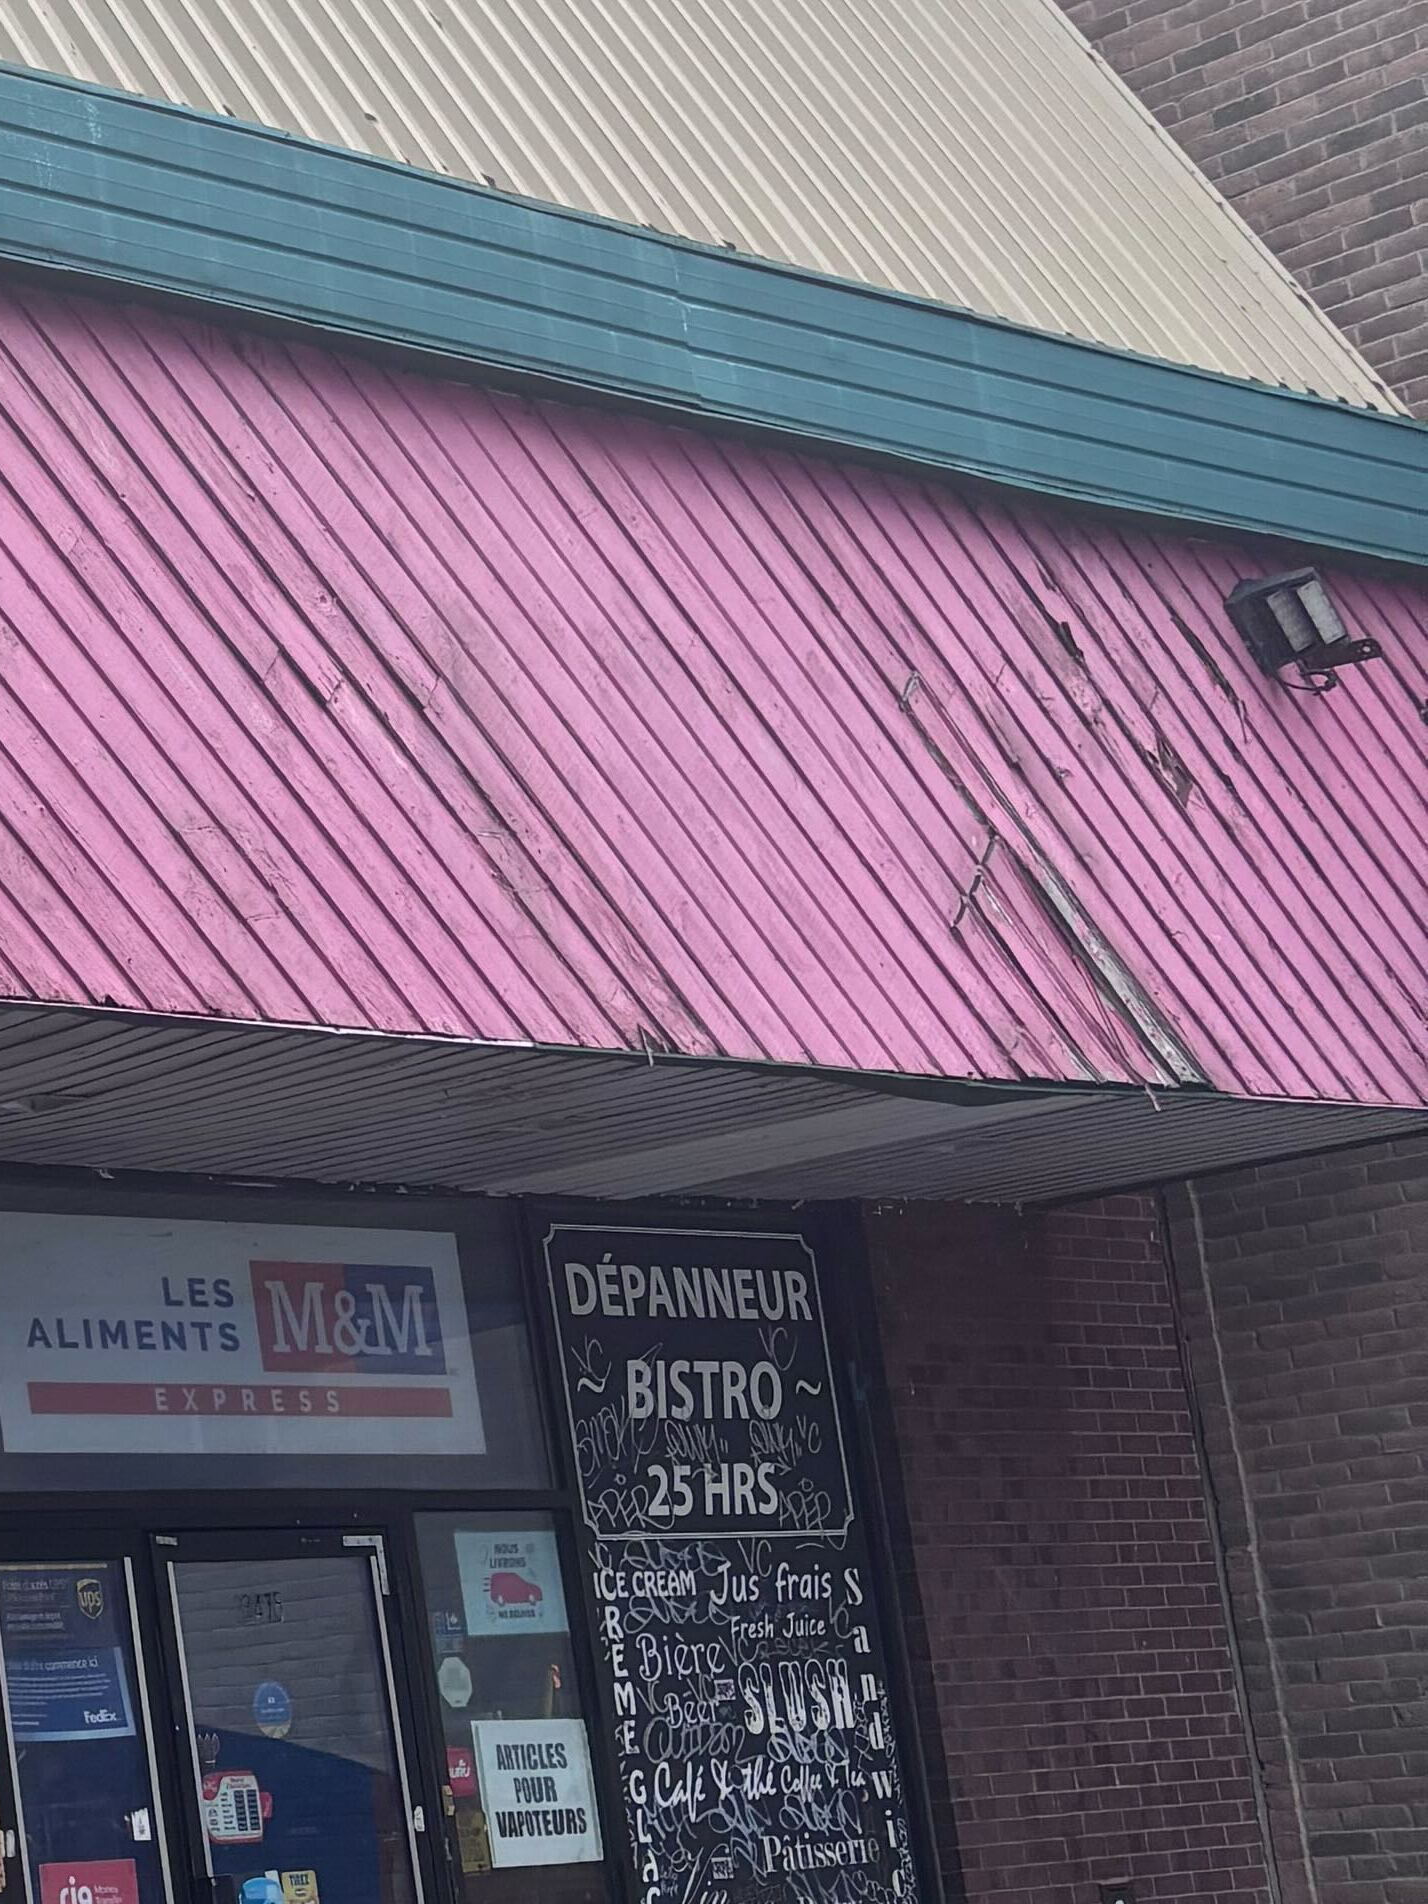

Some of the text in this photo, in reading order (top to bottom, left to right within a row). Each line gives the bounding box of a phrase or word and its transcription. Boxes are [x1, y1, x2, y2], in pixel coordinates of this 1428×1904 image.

[160, 1276, 235, 1308] LES
[565, 1254, 813, 1321] DÉPANNEUR
[27, 1317, 241, 1352] ALIMENTS
[263, 1280, 434, 1357] M&M
[155, 1387, 341, 1413] EXPRESS
[626, 1359, 783, 1420] BISTRO
[647, 1463, 779, 1517] 25 HRS
[594, 1568, 697, 1601] ICE CREAM
[710, 1560, 832, 1606] Jus frais
[78, 1592, 104, 1614] ups
[729, 1611, 827, 1640] Fresh Juice
[635, 1631, 726, 1682] Bière
[663, 1692, 720, 1729] Beer
[737, 1659, 855, 1735] SLUSH
[83, 1708, 117, 1725] FedEx
[495, 1742, 568, 1771] ARTICLES
[512, 1775, 558, 1804] POUR
[654, 1759, 706, 1823] Café
[495, 1806, 588, 1839] VAPOTEURS
[760, 1832, 880, 1874] Pâtisserie
